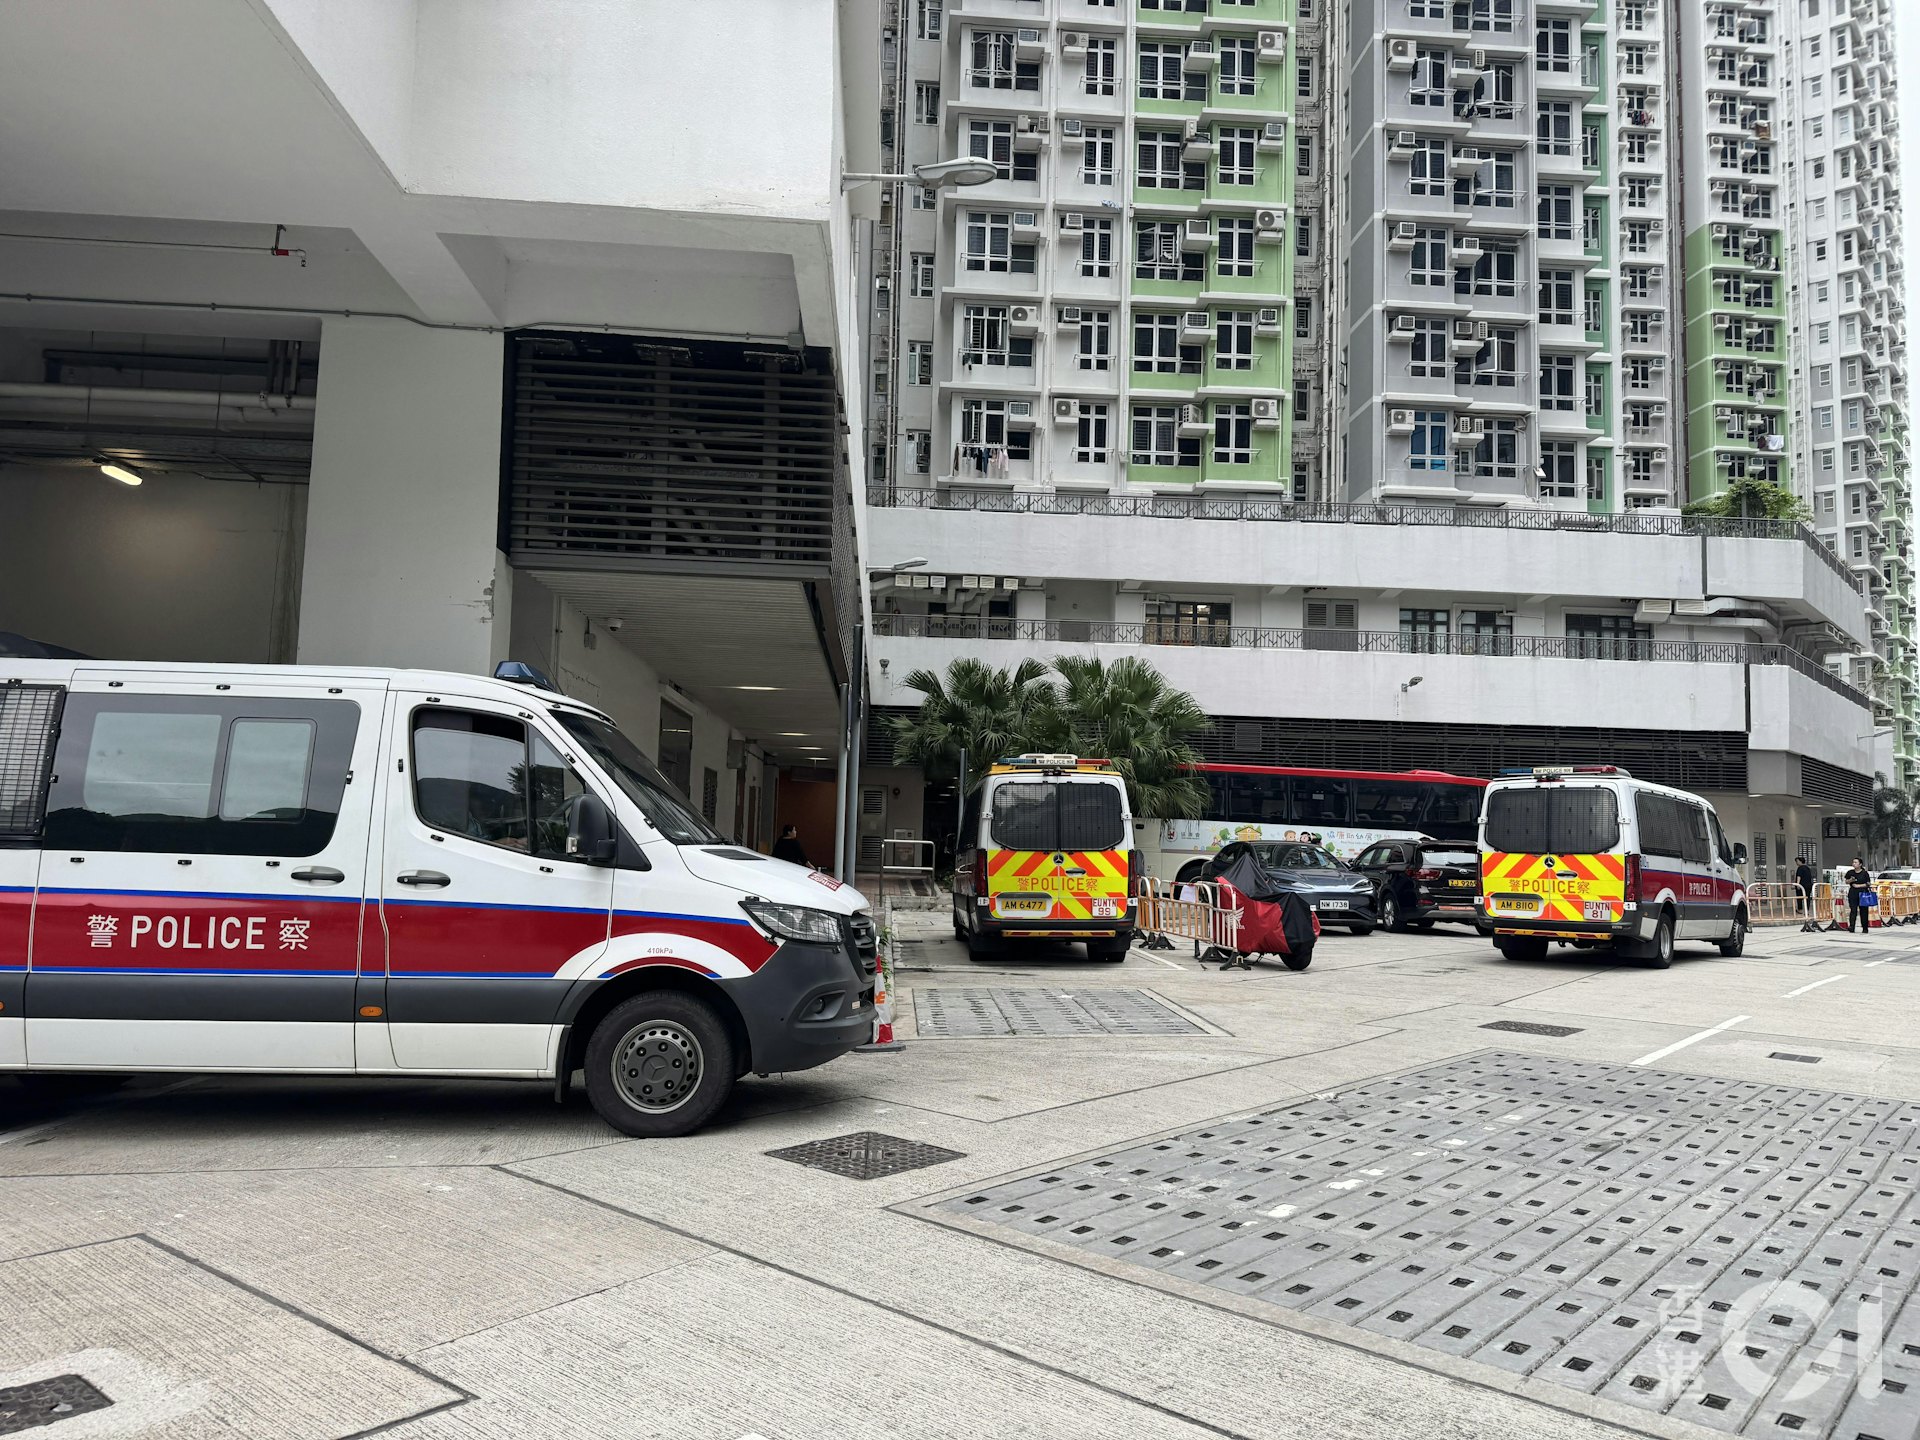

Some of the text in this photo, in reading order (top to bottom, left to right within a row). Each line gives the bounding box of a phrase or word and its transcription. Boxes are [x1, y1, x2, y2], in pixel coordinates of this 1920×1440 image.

[1017, 877, 1098, 892] 警 POLICE 察
[1522, 879, 1576, 894] POLICE
[1692, 882, 1707, 895] POLICE
[1004, 901, 1044, 910] AM 6477
[1092, 898, 1118, 907] EUNTN
[1332, 901, 1348, 909] 1738
[1500, 901, 1534, 910] AM 8110
[1098, 907, 1112, 916] 99
[1591, 909, 1603, 919] 81
[86, 914, 311, 951] 警 POLICE 察
[646, 947, 674, 955] 410kPa
